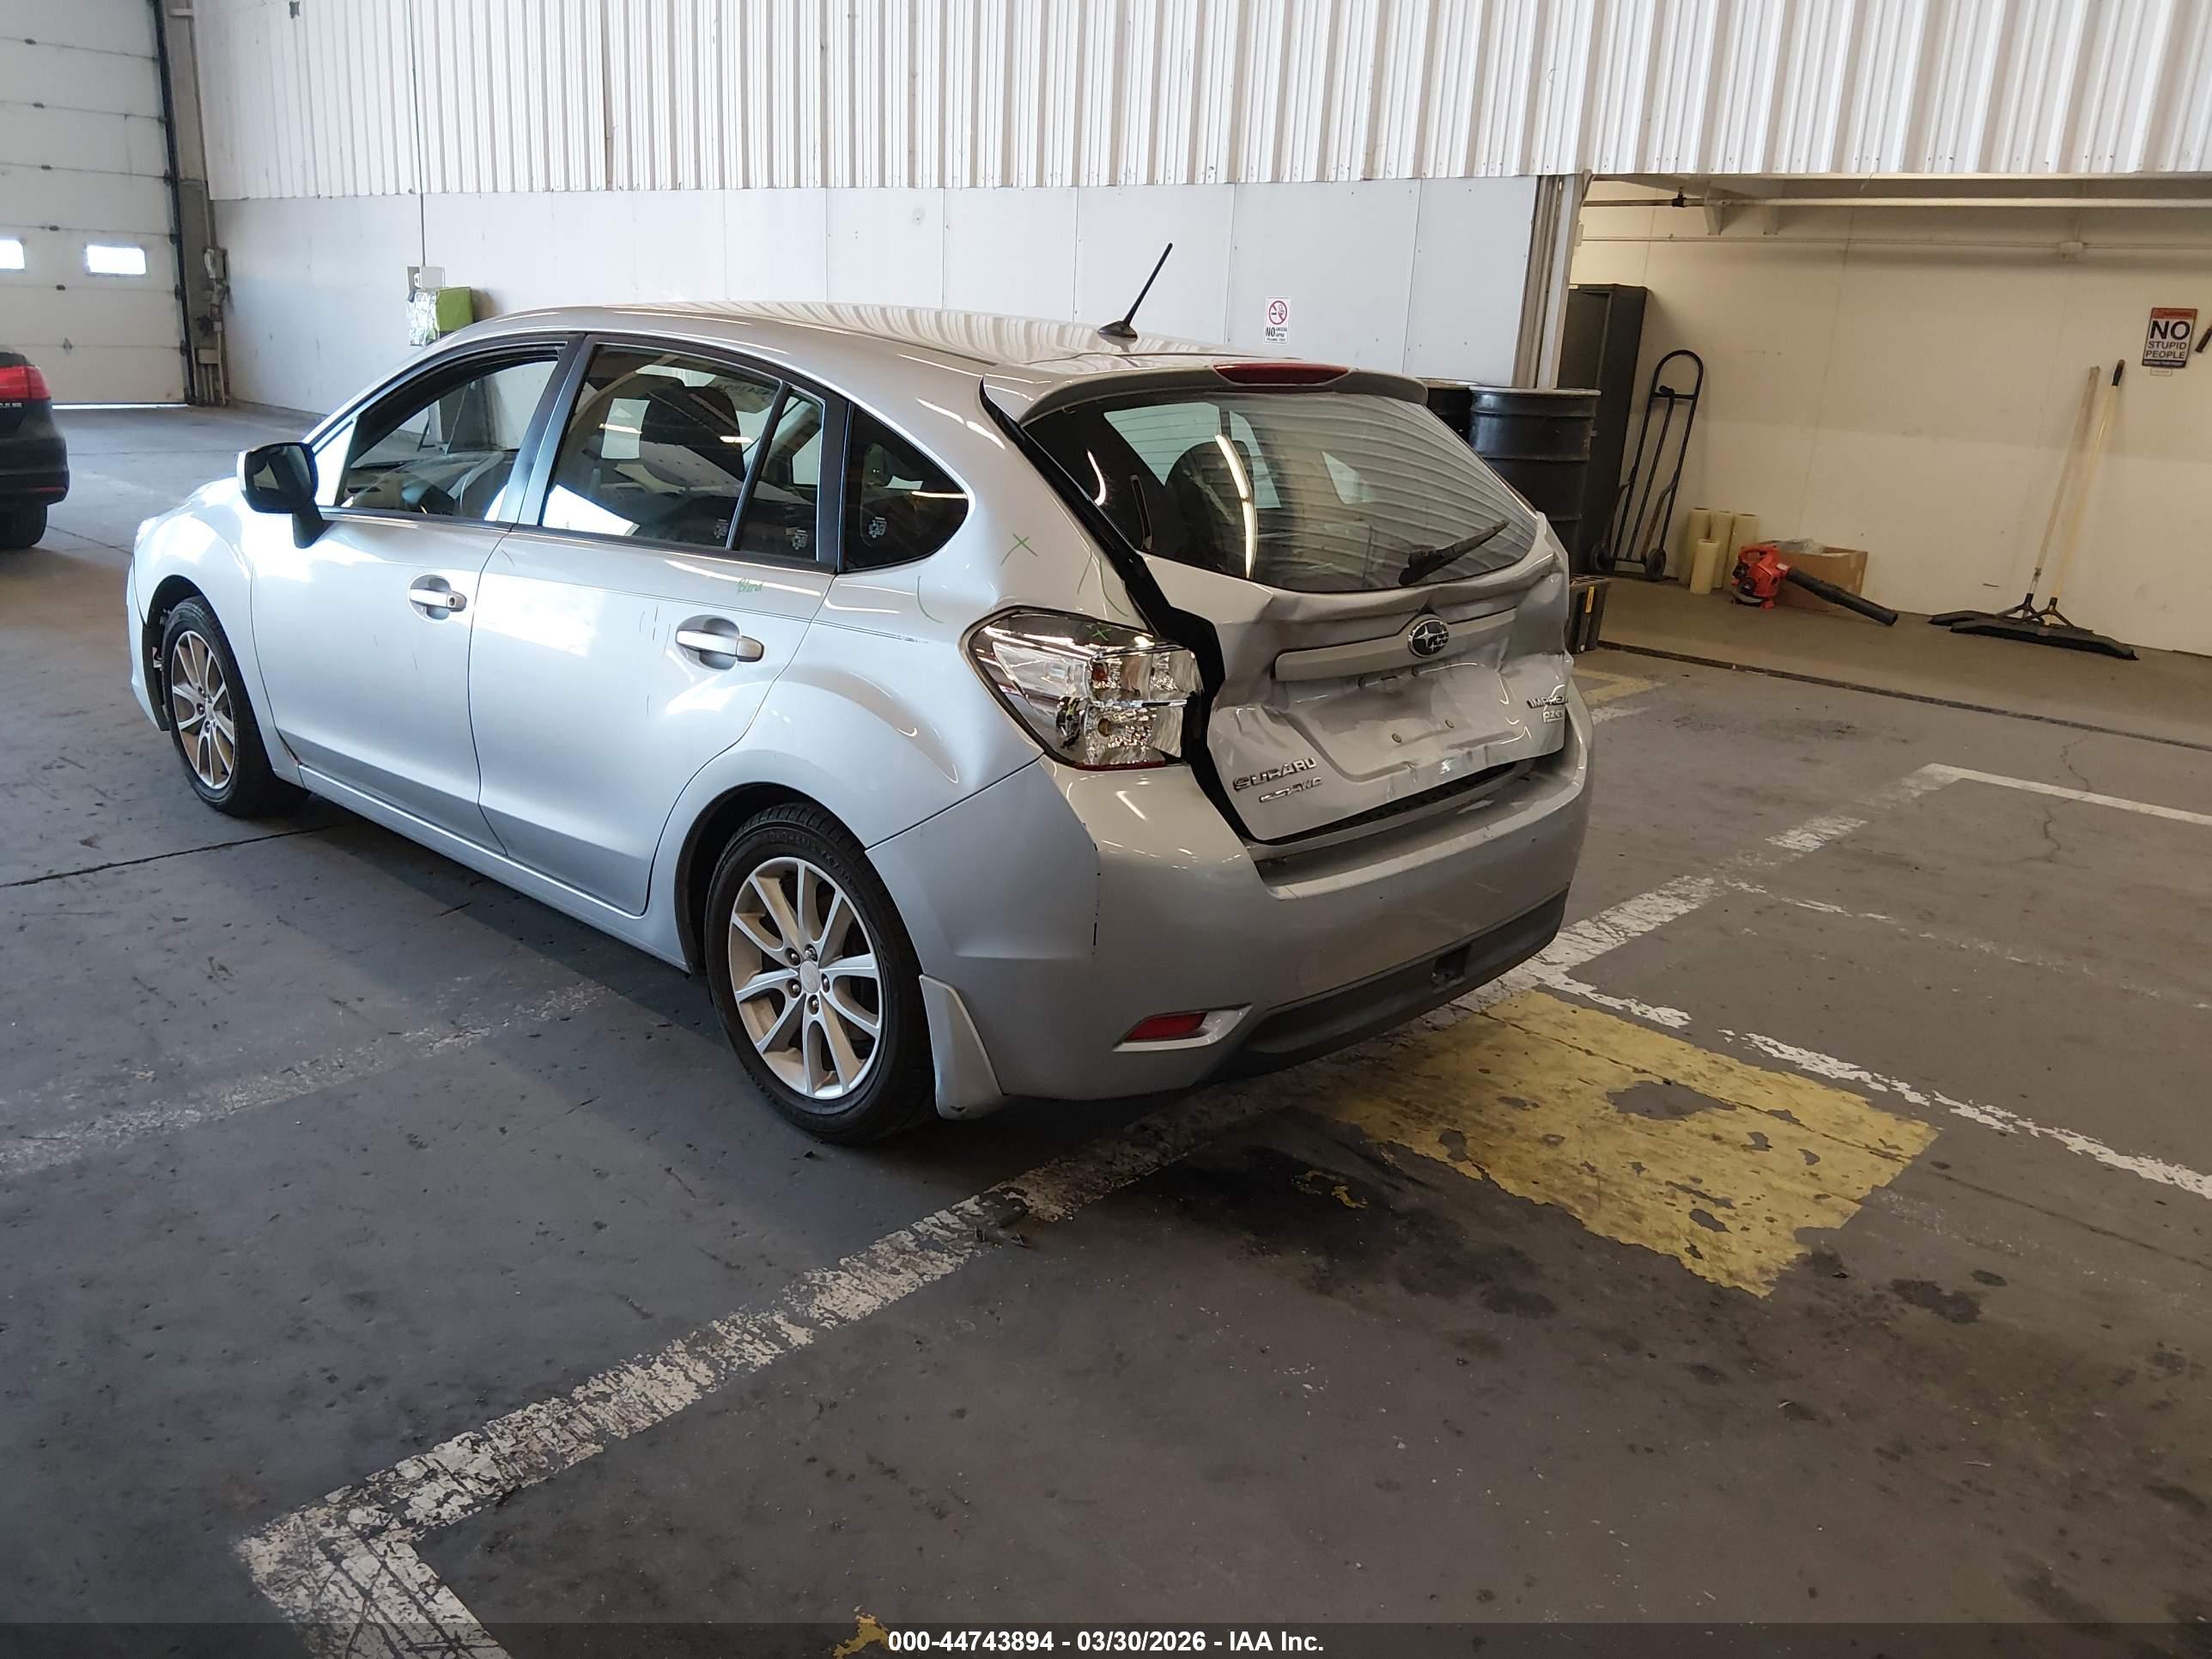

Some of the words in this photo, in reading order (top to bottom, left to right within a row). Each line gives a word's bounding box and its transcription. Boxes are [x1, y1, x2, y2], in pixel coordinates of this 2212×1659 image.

[1266, 327, 1275, 337] NO
[2149, 320, 2191, 340] NO
[2148, 341, 2187, 350] STUPID
[2146, 350, 2185, 359] PEOPLE
[1233, 757, 1317, 791] SUBARU
